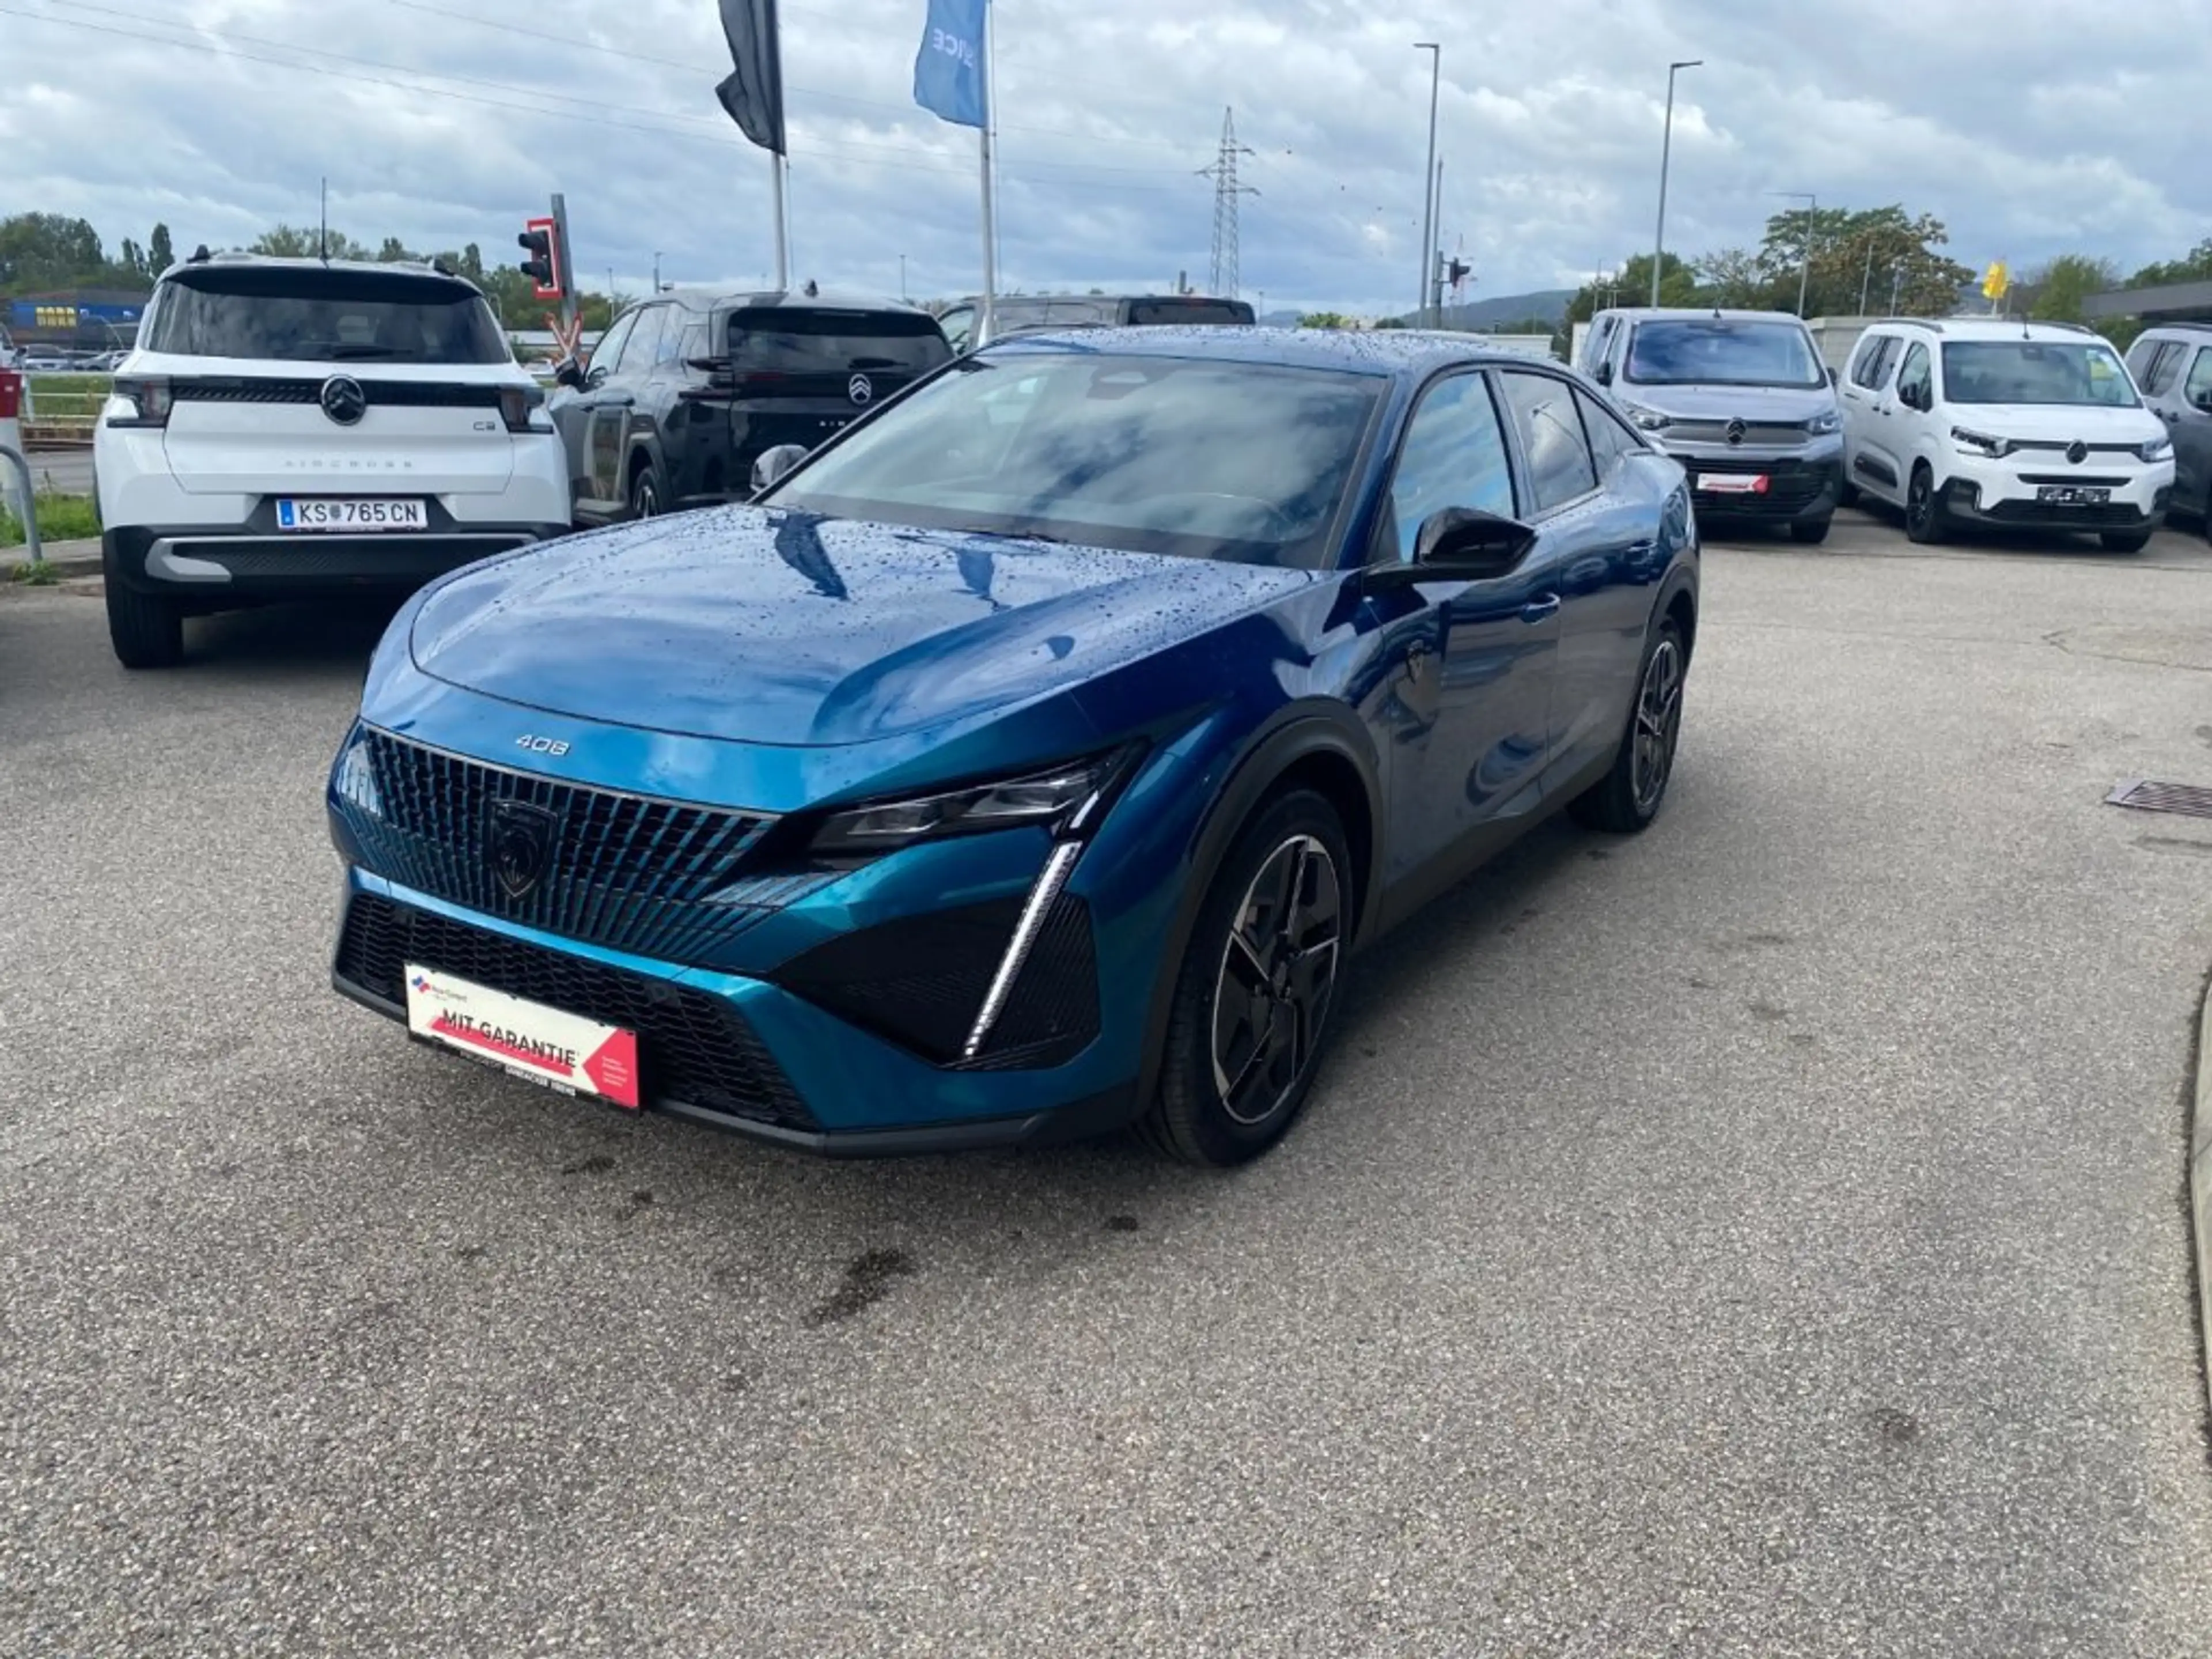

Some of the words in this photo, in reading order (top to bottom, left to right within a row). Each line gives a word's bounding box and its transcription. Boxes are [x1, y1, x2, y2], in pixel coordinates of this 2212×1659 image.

[300, 503, 328, 522] KS
[516, 734, 570, 756] 408
[442, 1007, 474, 1033] MIT
[479, 1021, 577, 1069] GARANTIE
